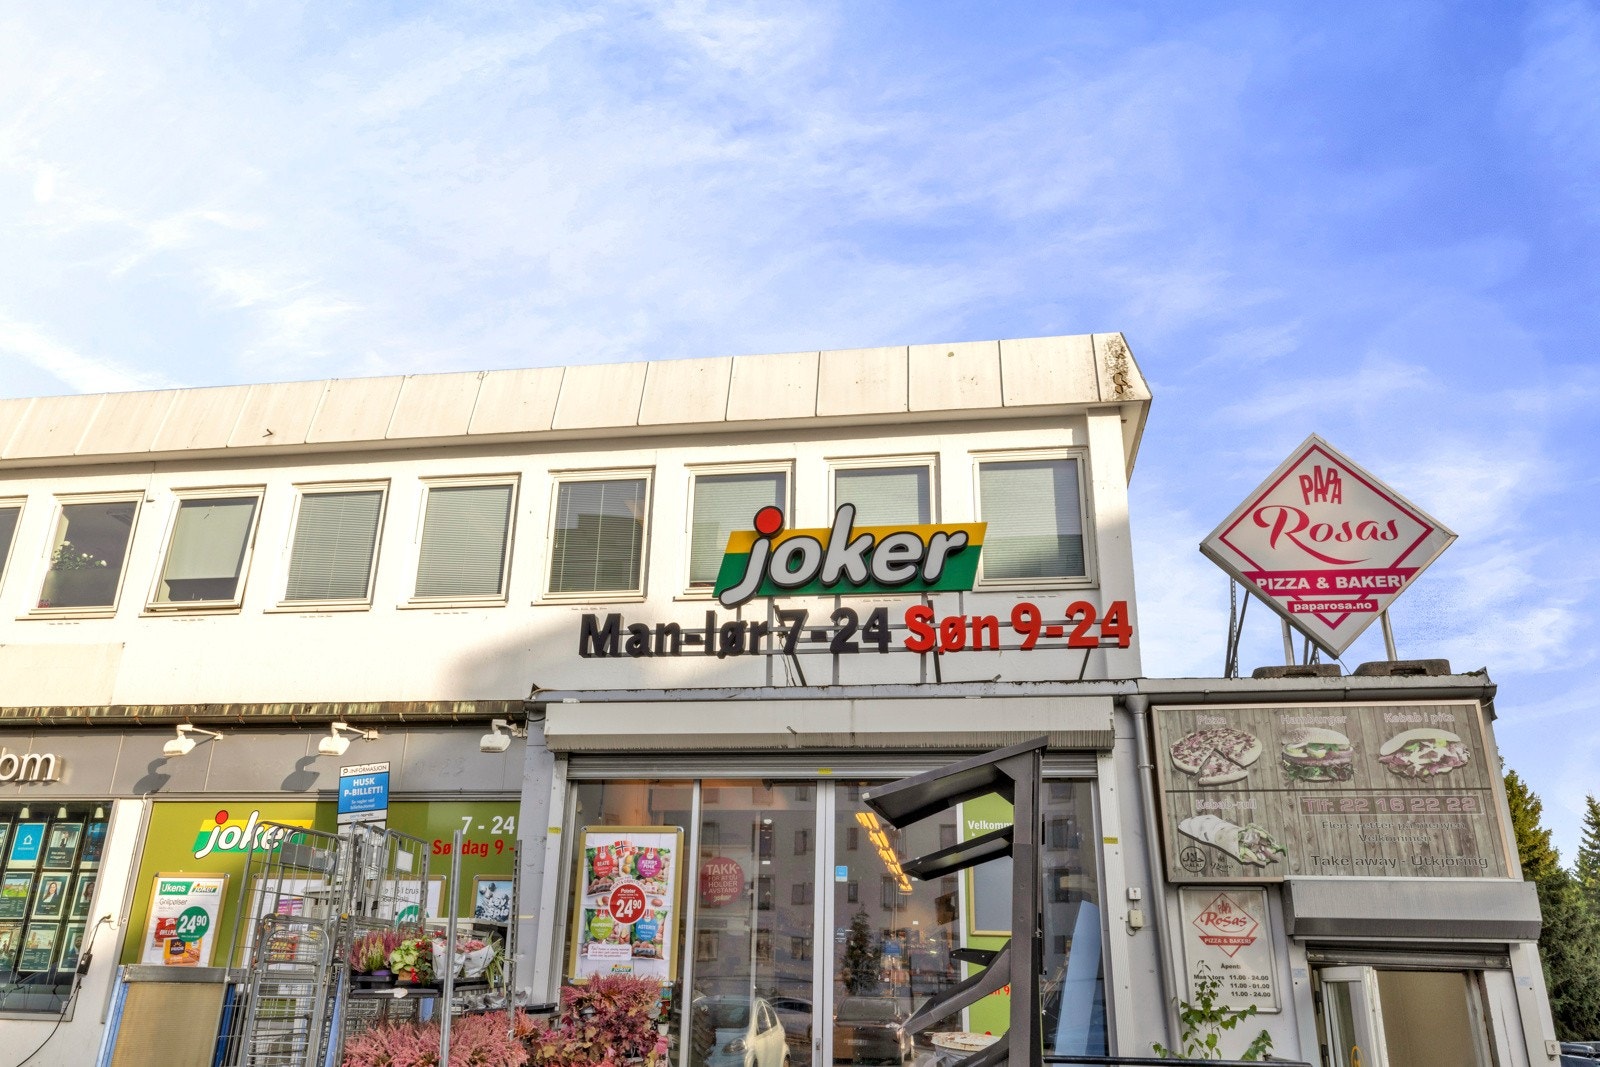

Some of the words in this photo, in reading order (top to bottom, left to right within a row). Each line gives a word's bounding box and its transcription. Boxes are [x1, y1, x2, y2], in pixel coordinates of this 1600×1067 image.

[1299, 465, 1342, 505] PAPA
[1253, 505, 1399, 565] Rosas
[719, 502, 970, 609] joker
[1256, 577, 1310, 590] PIZZA
[1316, 577, 1330, 589] &
[1336, 574, 1406, 589] BAKERI
[1294, 602, 1372, 612] paparosa.no
[579, 610, 769, 659] Man-lør
[774, 606, 892, 655] 7-24
[904, 605, 1000, 655] Søn
[1011, 601, 1133, 651] 9-24
[1281, 714, 1347, 726] Hamburger
[1384, 712, 1423, 723] Kebab
[353, 777, 375, 787] HUSK
[344, 786, 383, 797] P-BILLETT!
[1340, 798, 1369, 812] 22
[1376, 798, 1404, 812] 16
[1411, 798, 1440, 812] 22
[1446, 798, 1476, 812] 22
[461, 816, 473, 835] 7
[491, 816, 515, 835] 24
[432, 838, 489, 858] Sødag
[494, 839, 504, 855] 9
[1311, 855, 1350, 866] Take
[1356, 857, 1396, 868] away
[162, 882, 186, 893] Ukens
[1200, 911, 1247, 932] Rosas
